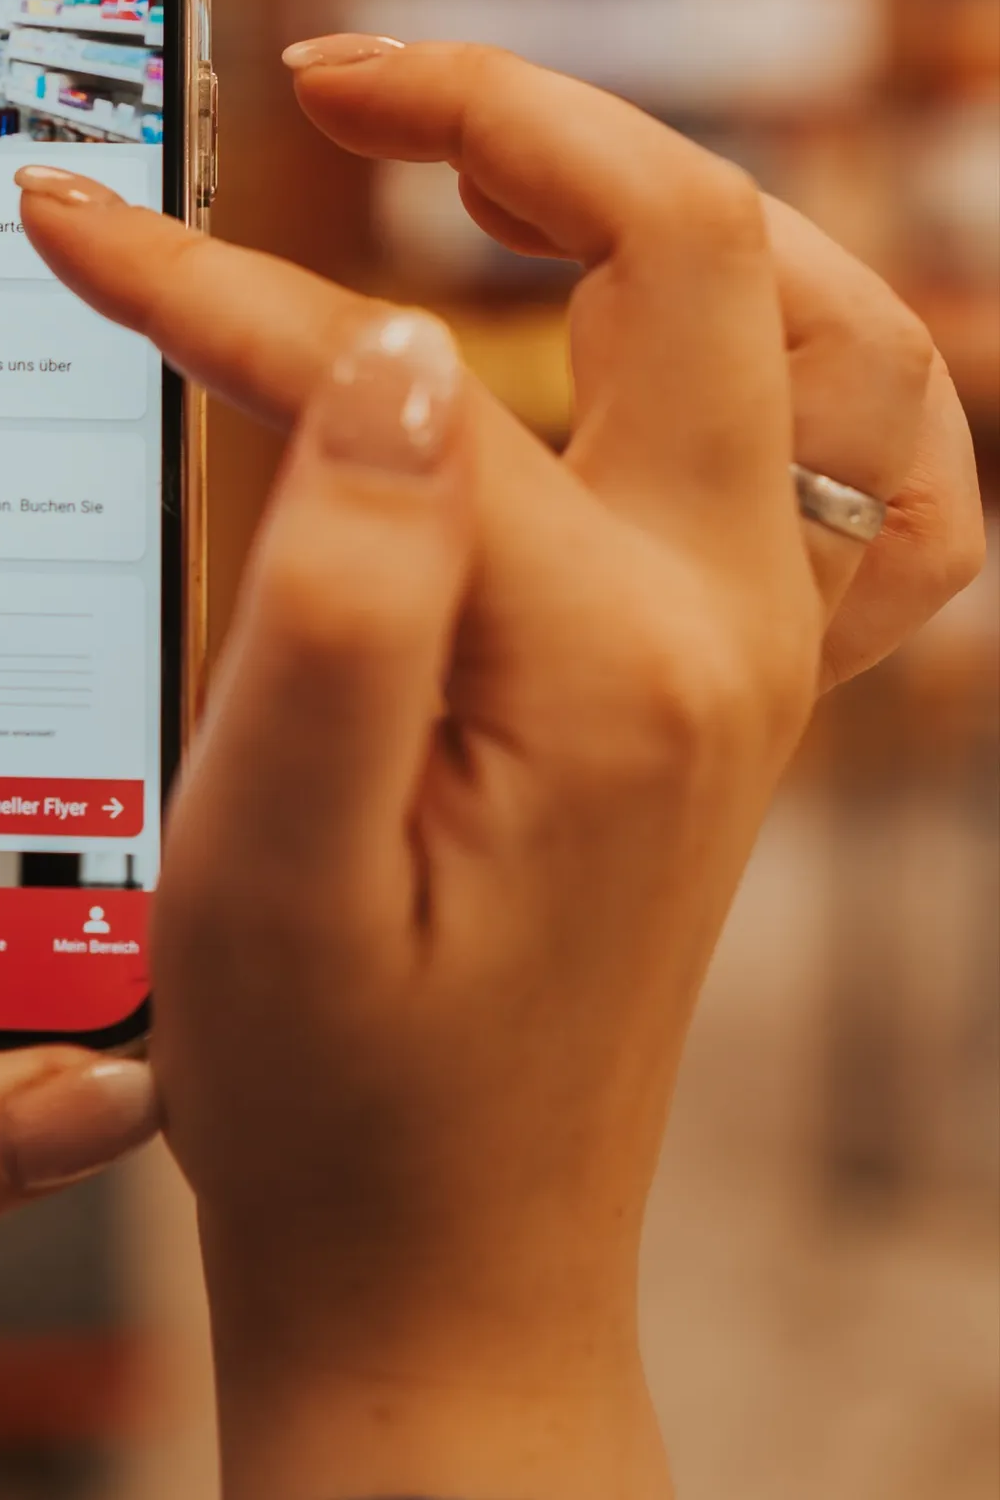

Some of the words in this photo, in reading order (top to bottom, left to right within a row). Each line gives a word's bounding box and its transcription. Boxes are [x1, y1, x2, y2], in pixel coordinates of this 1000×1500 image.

[7, 360, 35, 372] uns
[39, 358, 72, 373] über
[20, 498, 76, 514] Buchen
[80, 500, 104, 514] Sie
[43, 796, 88, 821] Flyer
